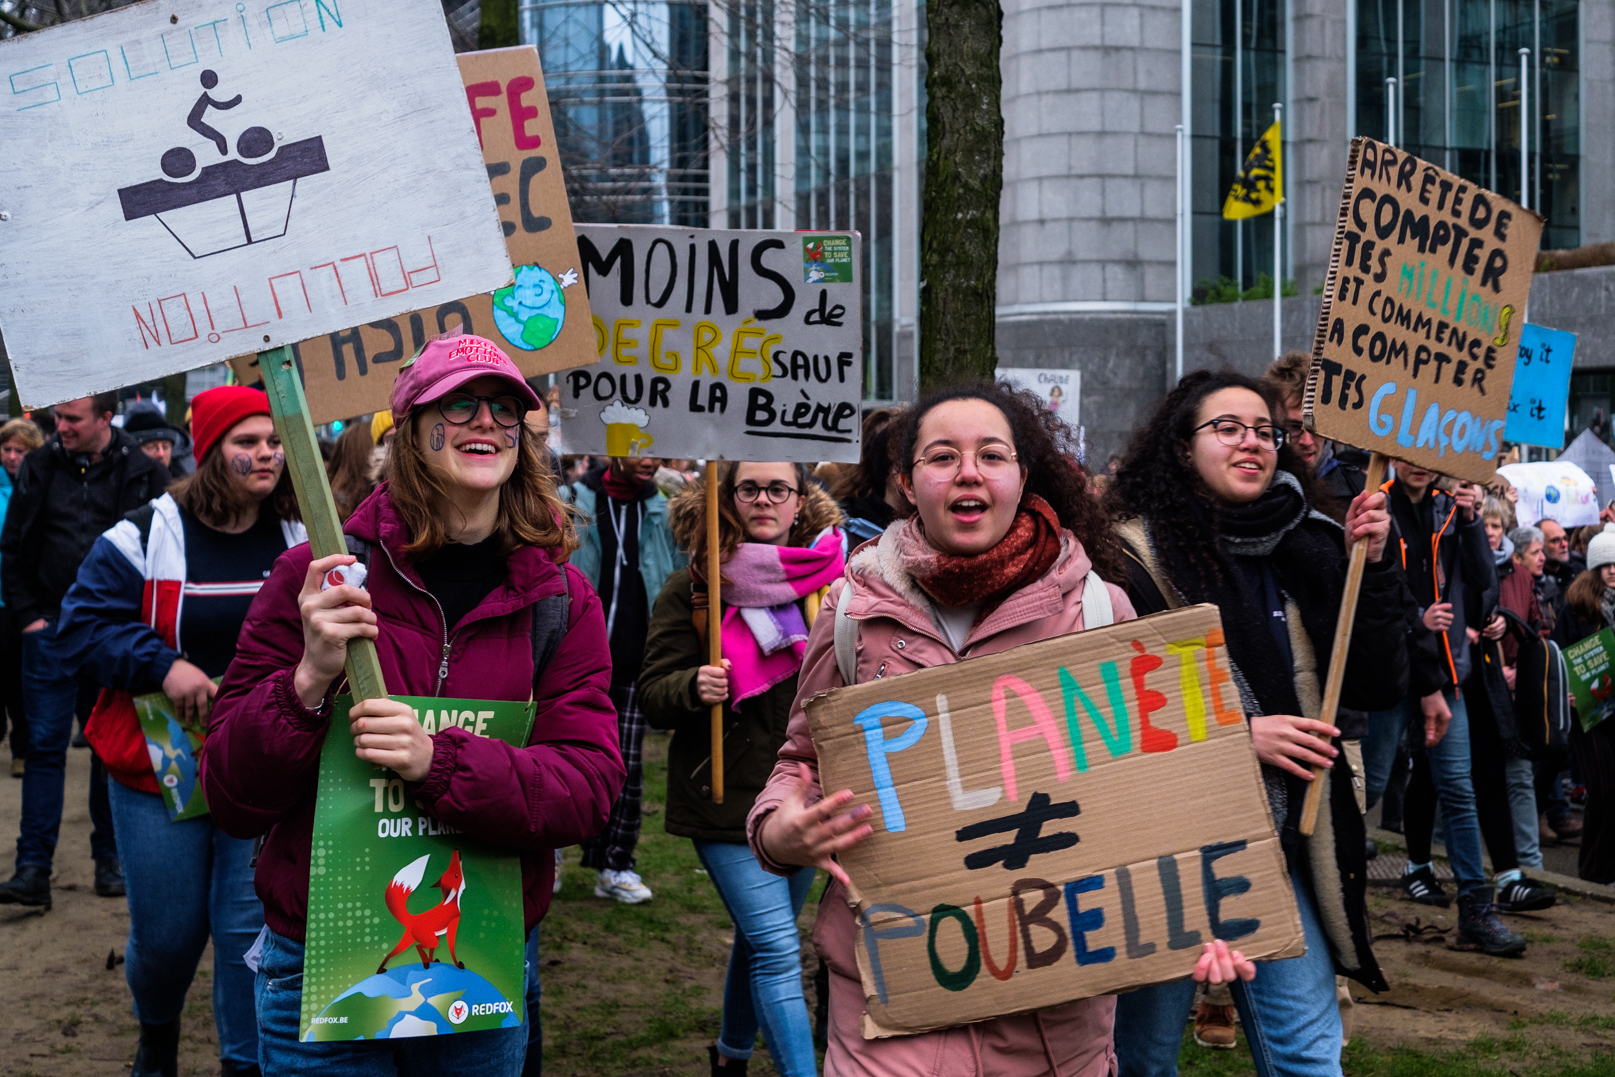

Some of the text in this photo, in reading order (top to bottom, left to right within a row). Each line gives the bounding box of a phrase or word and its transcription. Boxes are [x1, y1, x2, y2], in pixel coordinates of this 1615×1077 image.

[1344, 230, 1393, 283] TES
[1352, 187, 1508, 294] COMPTER
[804, 288, 846, 326] de
[1338, 275, 1498, 370] ET COMMENCE
[467, 354, 500, 366] CLUB
[771, 349, 855, 383] SAUF
[1329, 317, 1487, 396] A COMPTER
[1539, 342, 1553, 364] it
[566, 369, 671, 408] POUR
[689, 379, 728, 414] LA
[1529, 398, 1546, 420] it
[1320, 358, 1505, 461] TES GLAÇONS
[1567, 634, 1603, 660] CHANGE
[1586, 650, 1610, 670] SAVE
[413, 709, 495, 738] ANGE
[854, 628, 1242, 832] PLANÈTE
[369, 778, 405, 813] TO
[378, 817, 463, 838] OUR PLAN
[860, 838, 1261, 1005] POUBELLE
[471, 1001, 514, 1016] REDFOX
